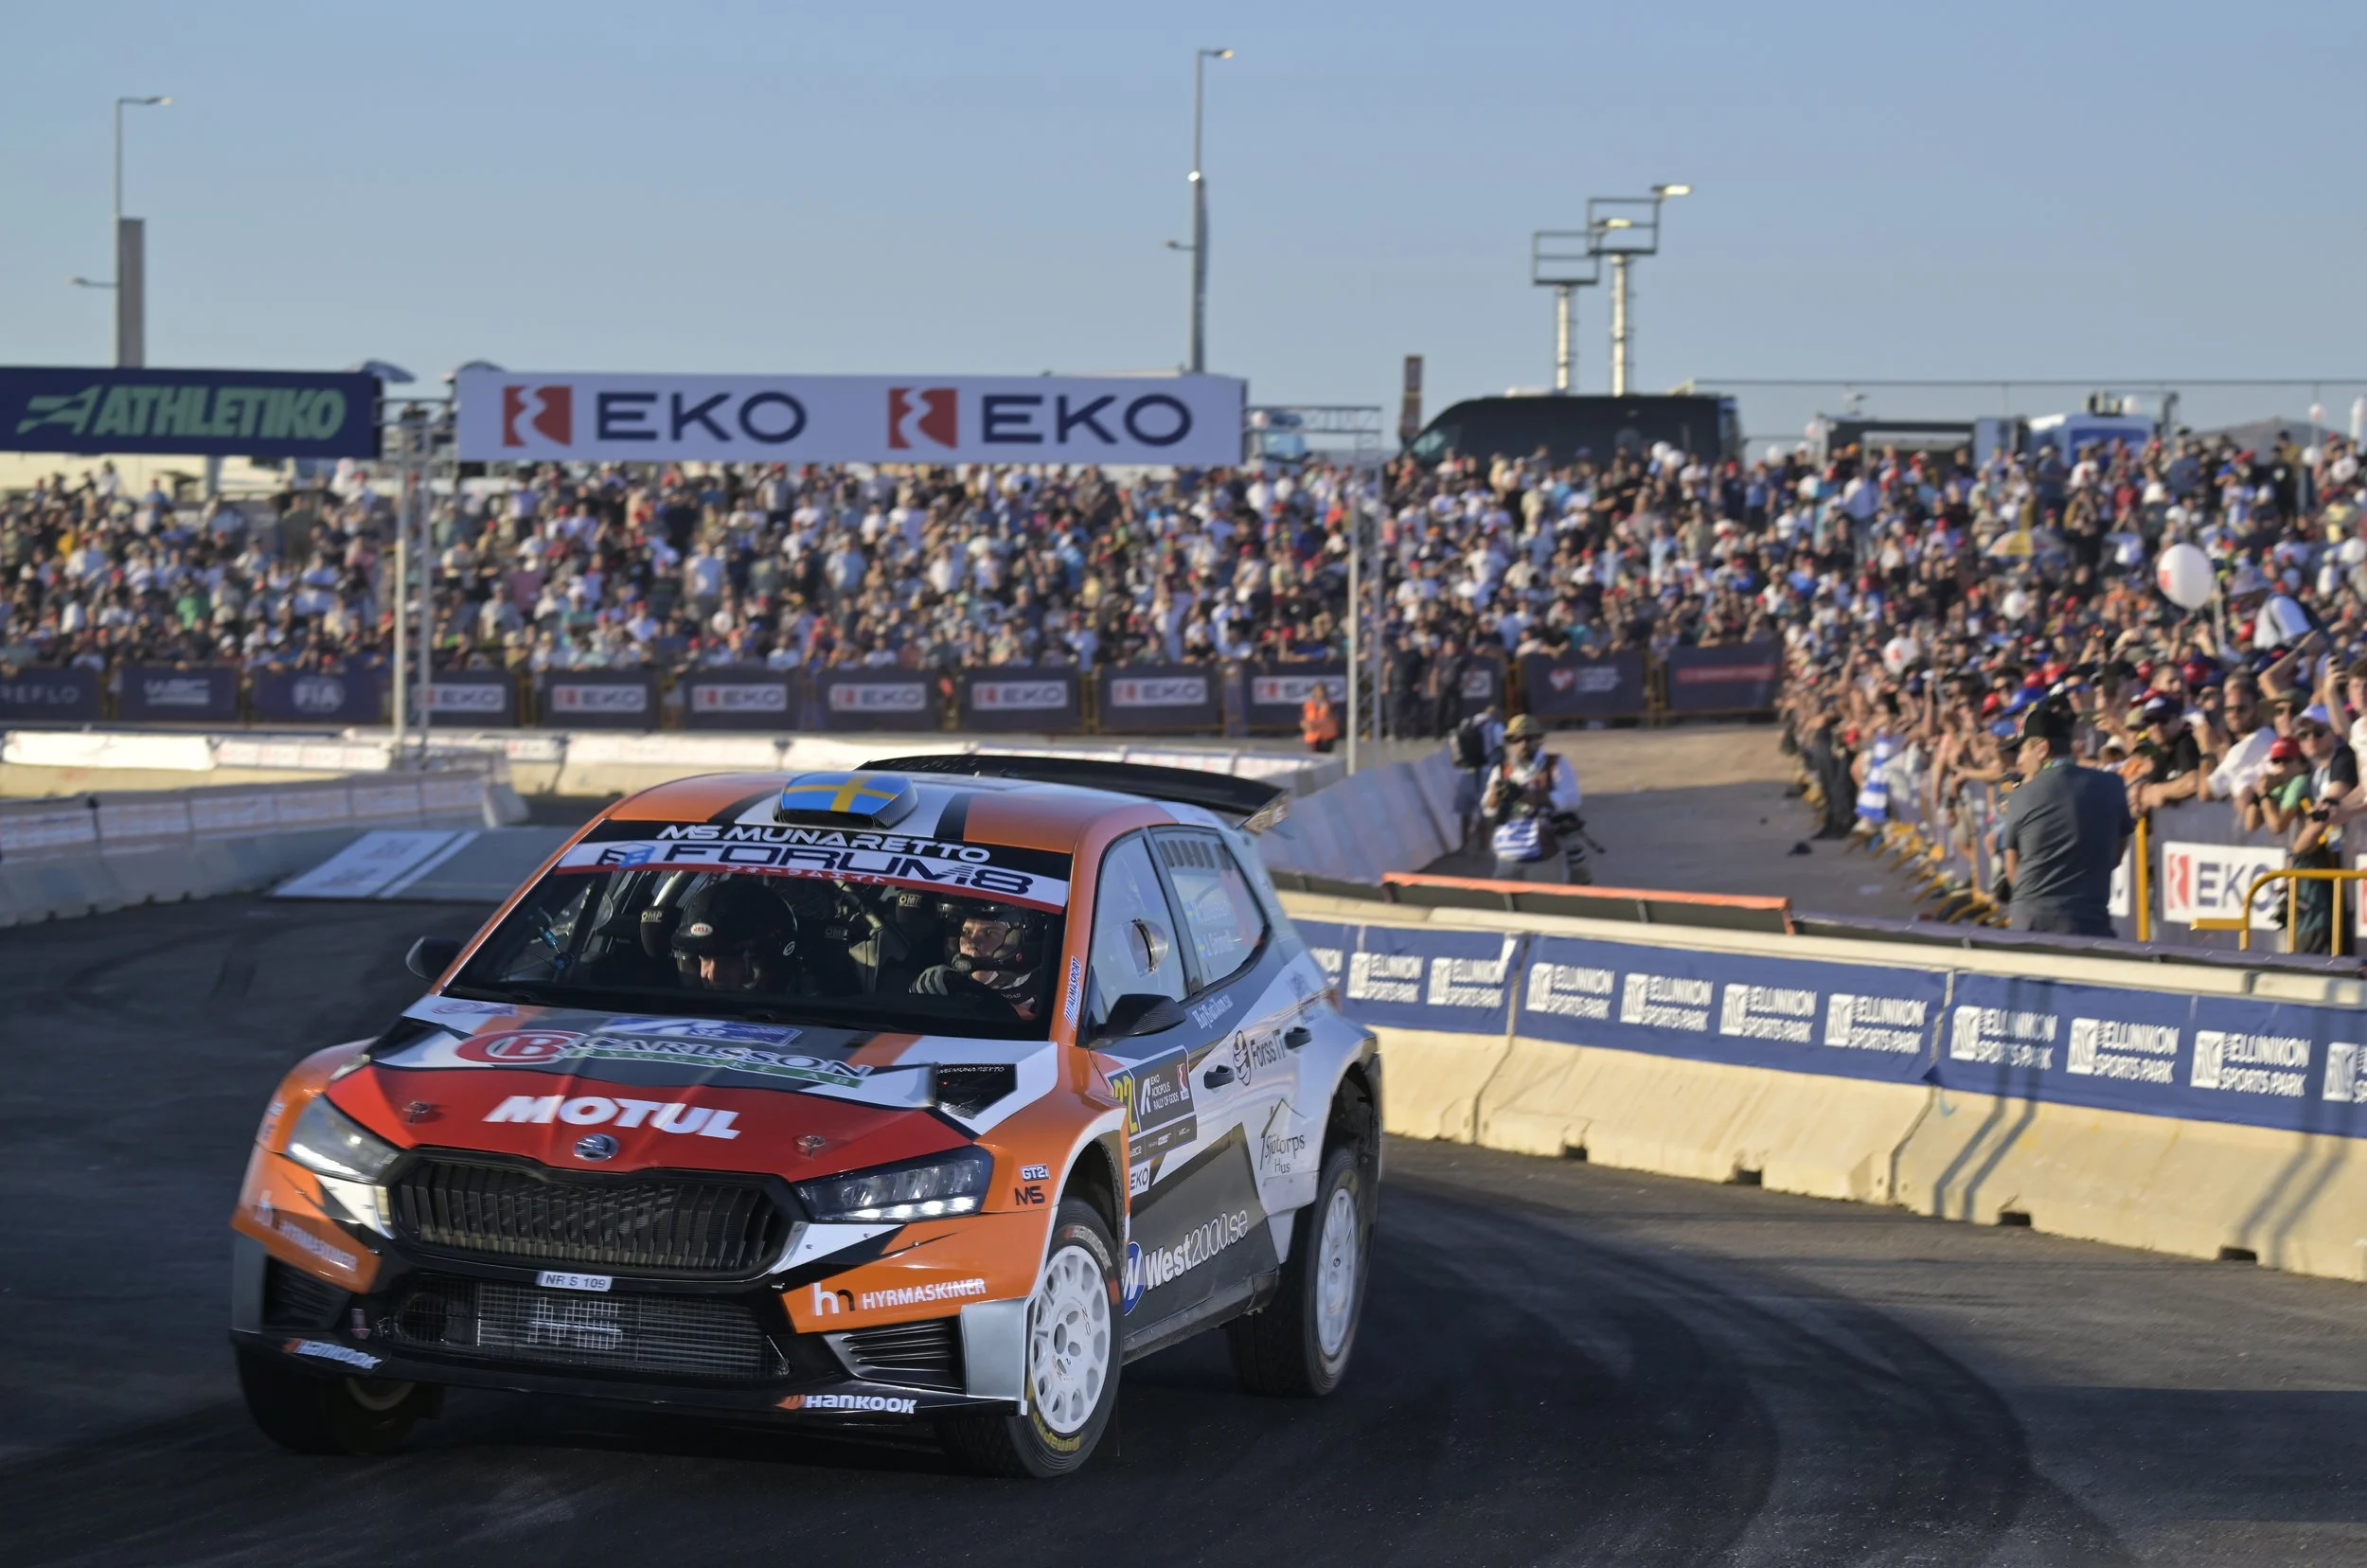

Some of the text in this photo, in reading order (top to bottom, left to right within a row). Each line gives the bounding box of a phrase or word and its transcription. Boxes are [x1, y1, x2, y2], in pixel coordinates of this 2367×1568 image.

[93, 385, 347, 440] ATHLETIKO
[596, 391, 808, 443] EKO
[982, 394, 1192, 446] EKO
[656, 824, 991, 864] MS MUNARETTO
[659, 843, 1034, 895] FORUM8
[641, 911, 662, 921] OMP
[1068, 956, 1080, 1008] ALMASPORT
[591, 1035, 875, 1078] CARLSSON
[1251, 1033, 1277, 1070] Forss
[804, 1072, 852, 1086] AB
[1150, 1074, 1161, 1085] EKO
[1151, 1081, 1171, 1097] ACROPOLIS
[1153, 1096, 1165, 1110] RALLY
[1168, 1092, 1180, 1104] GODS
[483, 1095, 741, 1140] MOTUL
[1023, 1166, 1049, 1180] GT2i
[1130, 1167, 1148, 1190] EKO
[1274, 1157, 1290, 1174] Hus
[1014, 1185, 1045, 1205] MS
[1145, 1209, 1248, 1291] West2000.se
[544, 1274, 606, 1291] NR S 109
[862, 1278, 987, 1310] HYRMASKINER
